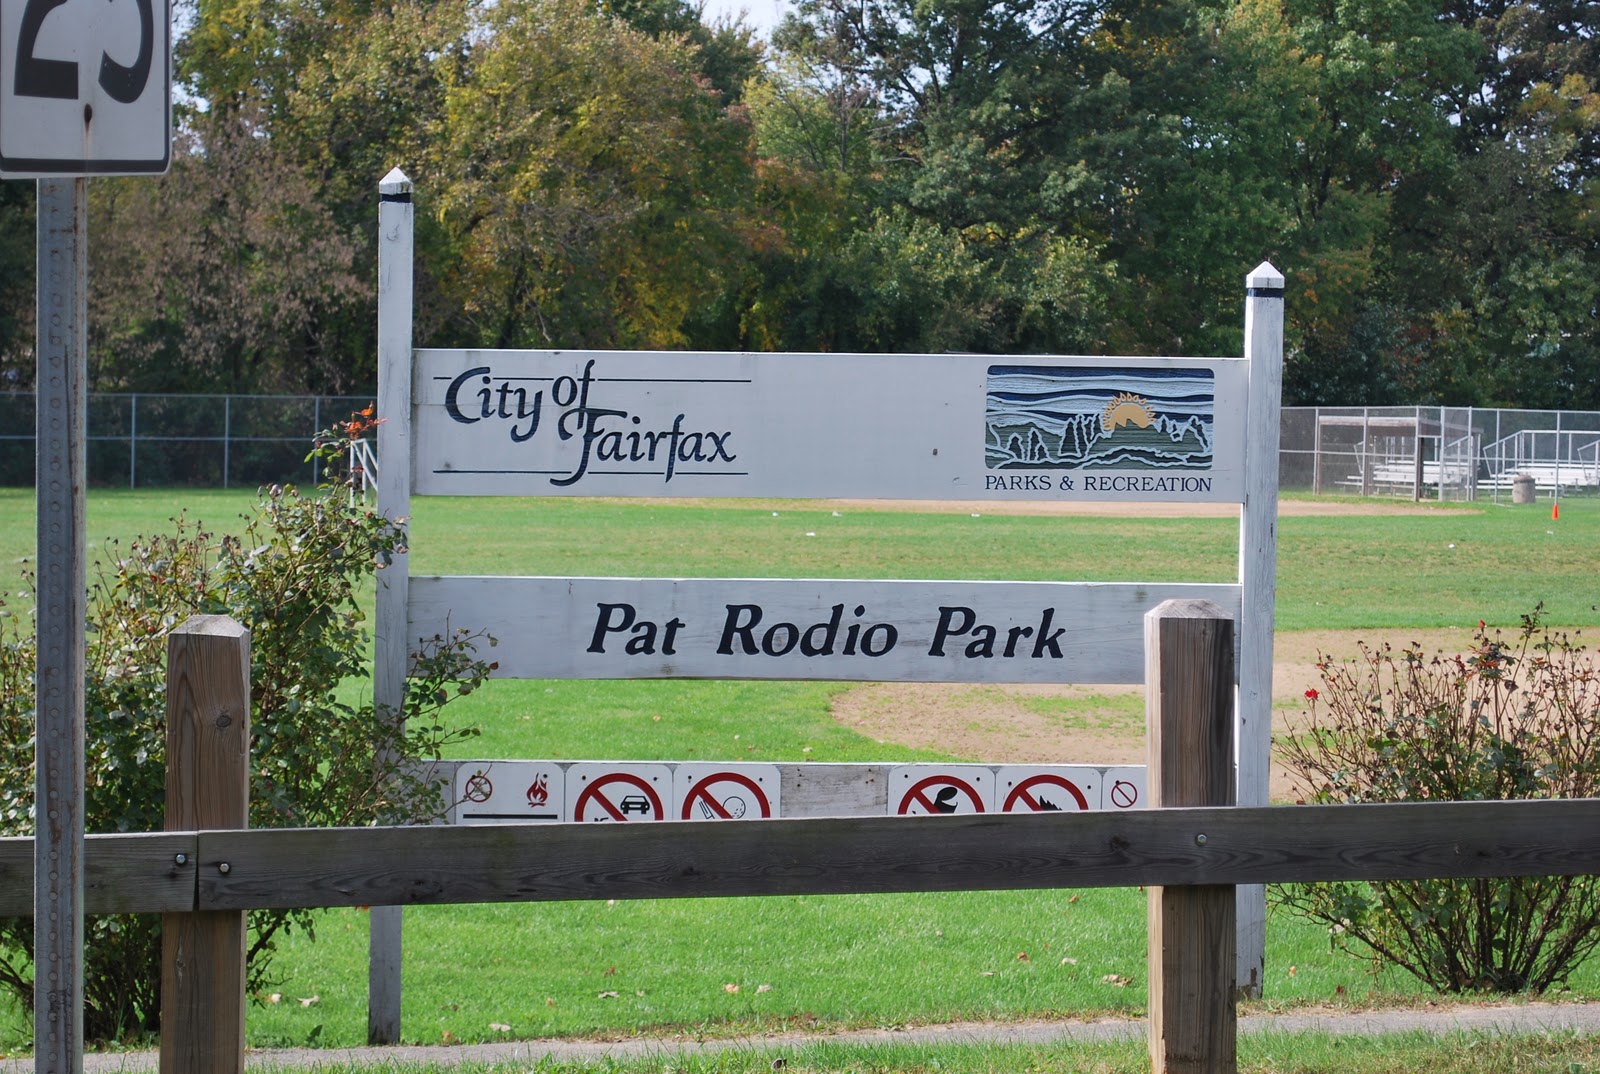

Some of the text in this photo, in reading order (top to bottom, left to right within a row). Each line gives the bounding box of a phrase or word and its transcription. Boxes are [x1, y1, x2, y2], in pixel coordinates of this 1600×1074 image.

[445, 359, 595, 443] City of
[549, 407, 737, 486] Fairfax
[985, 475, 1213, 492] PARKS & RECREATION
[586, 602, 1067, 659] Pat Rodio Park
